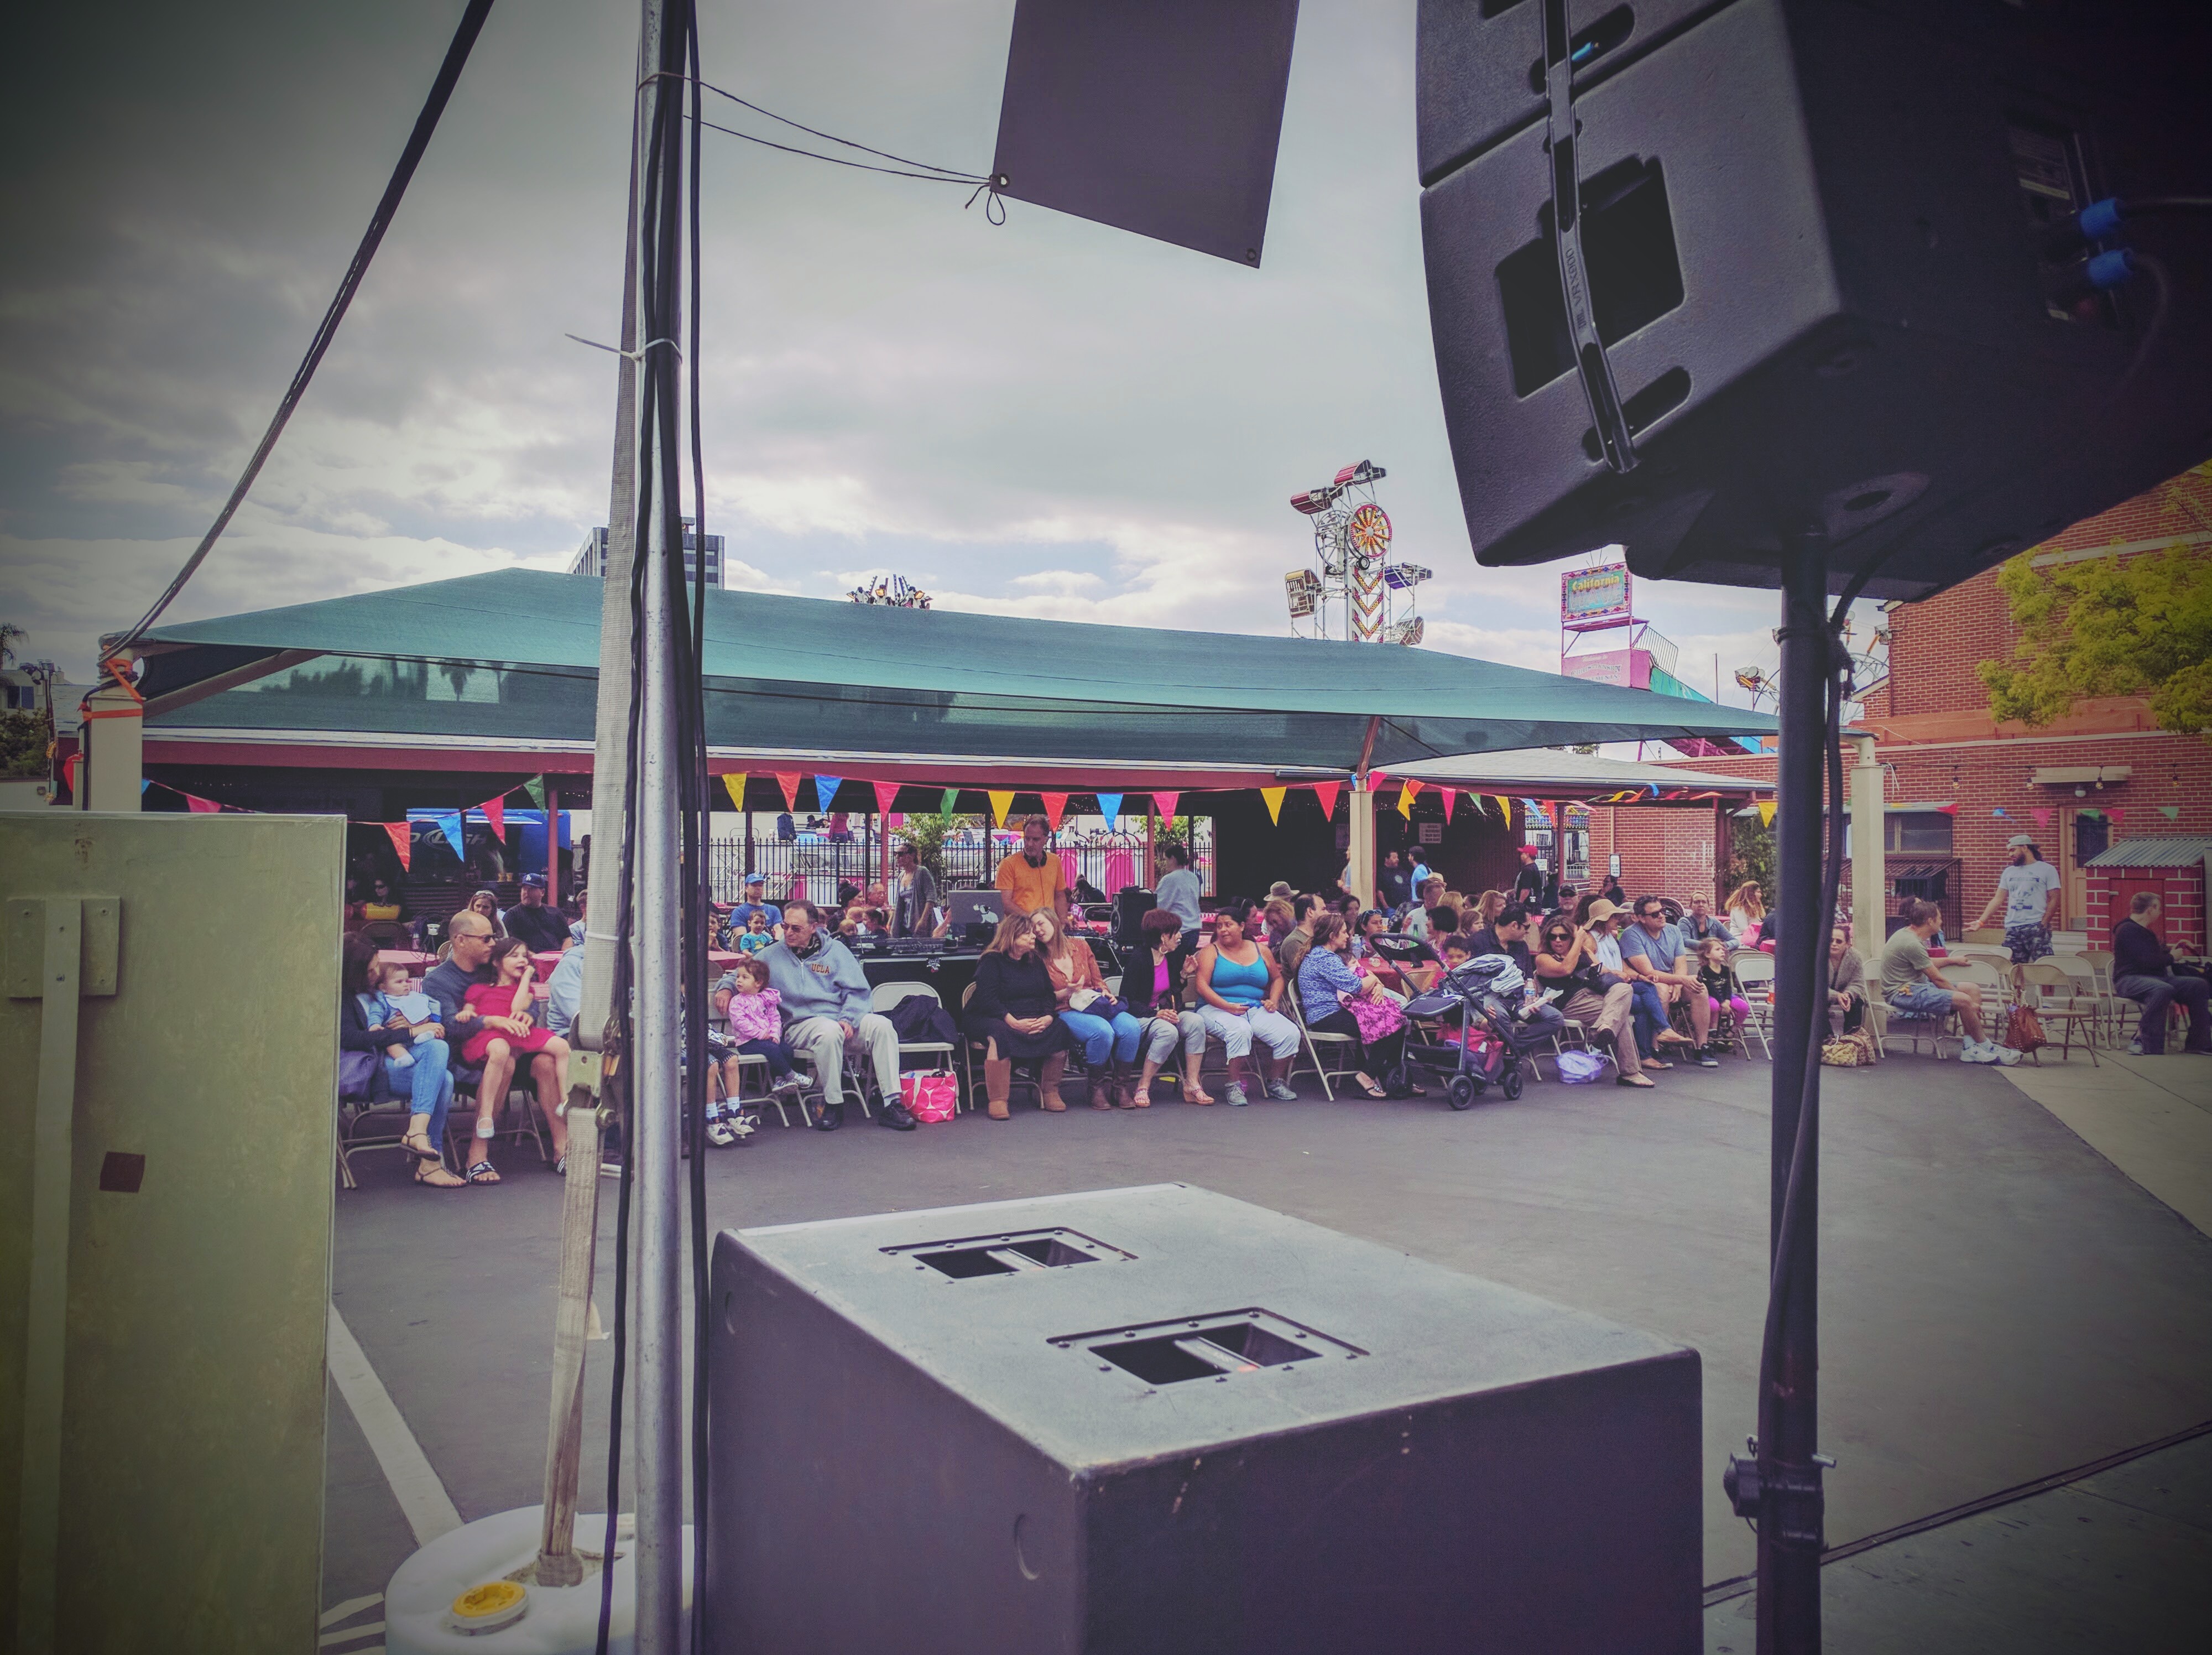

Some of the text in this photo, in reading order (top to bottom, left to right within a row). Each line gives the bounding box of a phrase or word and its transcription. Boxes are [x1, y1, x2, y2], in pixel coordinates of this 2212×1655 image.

[1572, 574, 1620, 591] California
[1570, 585, 1622, 610] WAVE
[811, 964, 830, 974] UCLA
